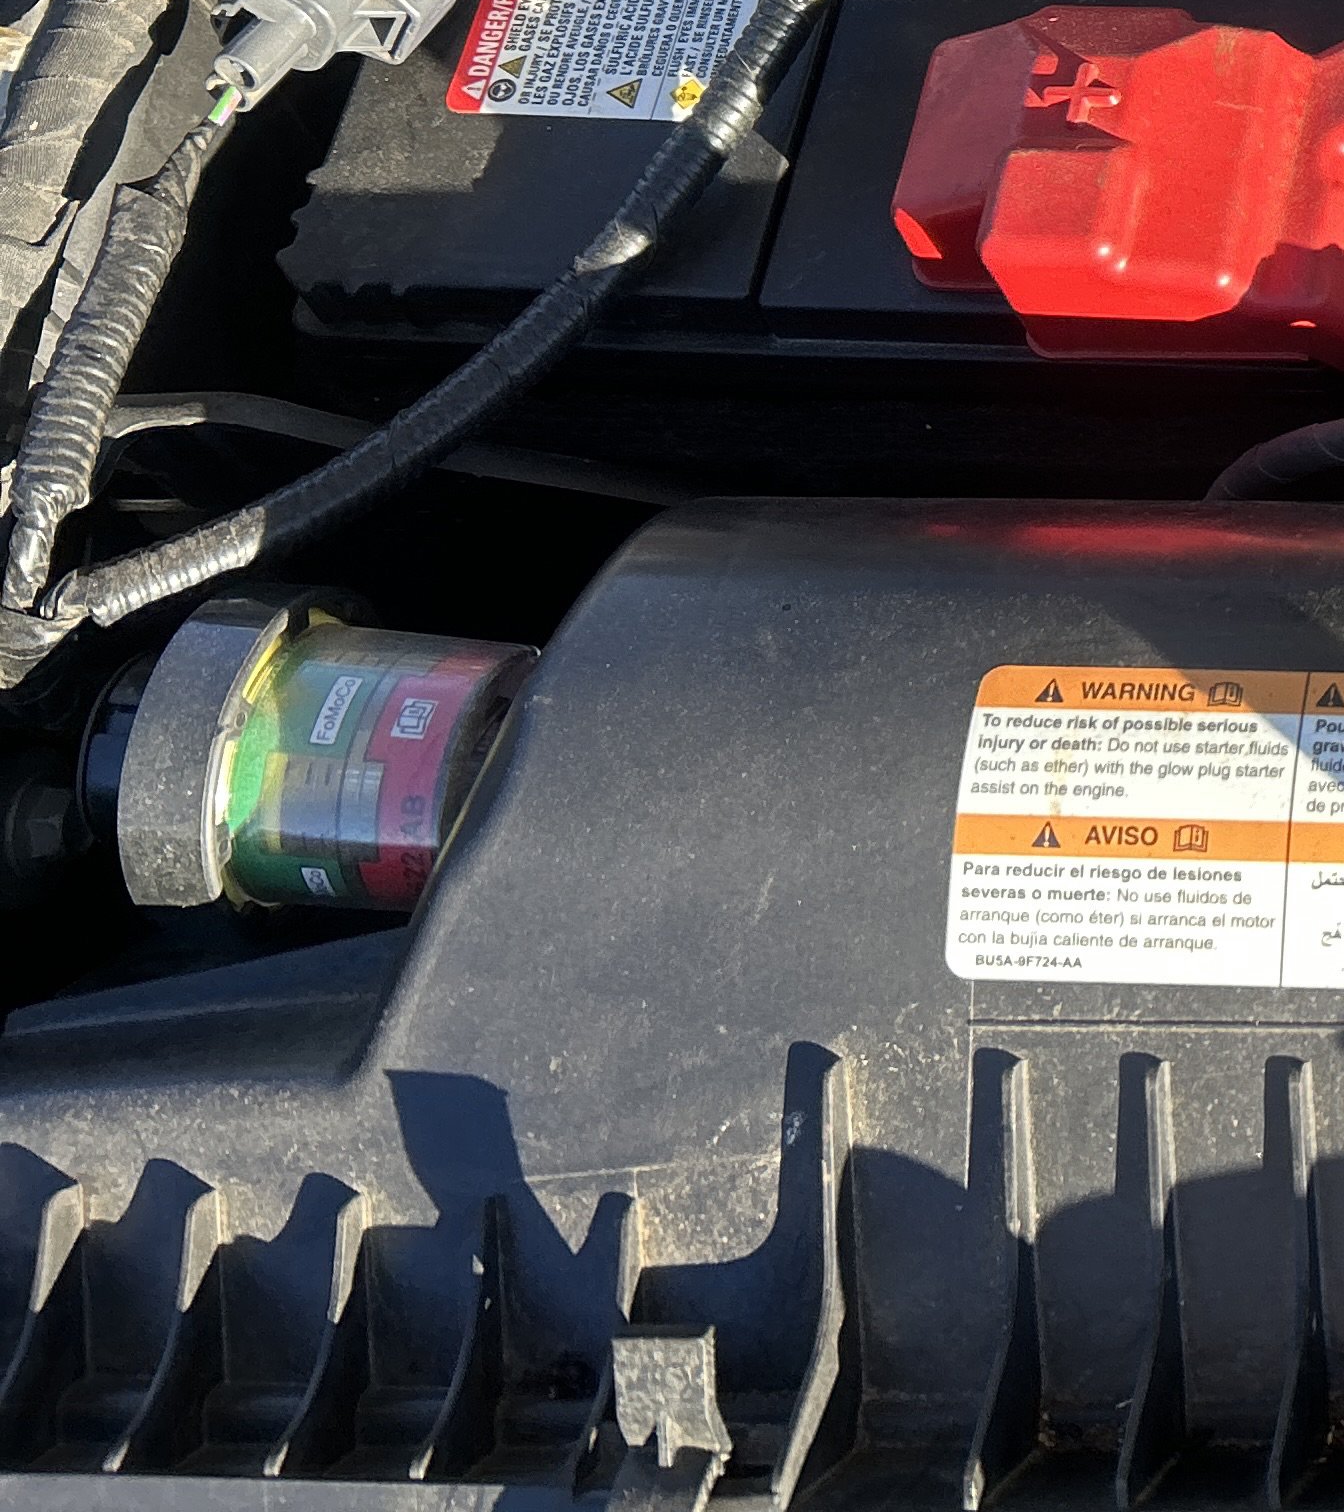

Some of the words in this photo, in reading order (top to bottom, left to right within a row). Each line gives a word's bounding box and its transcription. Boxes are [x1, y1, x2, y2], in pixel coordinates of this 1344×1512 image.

[504, 14, 526, 50] SHIELD
[519, 16, 539, 50] GASES
[581, 13, 601, 47] GASES
[574, 51, 589, 70] LOS
[604, 24, 631, 74] SULFURIC
[1079, 679, 1196, 702] WARNING
[314, 676, 356, 741] FoMoCo
[981, 711, 1002, 727] To
[1005, 713, 1063, 729] reduce
[1065, 714, 1097, 730] risk
[1101, 715, 1120, 730] of
[1122, 715, 1193, 736] possible
[1196, 717, 1258, 733] serious
[976, 734, 1025, 753] injury
[1028, 737, 1047, 750] or
[1050, 736, 1103, 752] death:
[1106, 737, 1130, 752] Do
[1133, 739, 1159, 753] not
[1162, 741, 1191, 754] use
[1194, 739, 1244, 755] starter
[1248, 740, 1290, 756] fluids
[973, 756, 1017, 773] (such
[1019, 760, 1039, 773] as
[1042, 757, 1089, 776] ether)
[1093, 759, 1125, 774] with
[1128, 760, 1153, 775] the
[1156, 761, 1193, 779] glow
[1196, 761, 1231, 781] plug
[1234, 761, 1285, 778] starter
[969, 779, 1016, 795] assist
[1018, 782, 1039, 795] on
[1043, 781, 1068, 796] the
[1071, 781, 1130, 800] engine.
[1307, 779, 1344, 793] avec
[1305, 798, 1326, 813] de
[1084, 824, 1160, 847] AVISO
[962, 861, 1001, 876] Para
[1004, 861, 1066, 879] reducir
[1069, 864, 1085, 878] el
[1088, 864, 1143, 883] riesgo
[1146, 866, 1167, 881] de
[1172, 866, 1243, 882] lesiones
[961, 884, 1027, 899] severas
[1030, 887, 1043, 900] o
[1046, 886, 1112, 902] muerte:
[1116, 888, 1139, 902] No
[1142, 890, 1172, 903] use
[1176, 889, 1229, 905] fluidos
[1231, 891, 1252, 905] de
[958, 907, 1031, 926] arranque
[1034, 909, 1084, 926] (como
[1087, 909, 1125, 927] éter)
[1129, 911, 1143, 925] si
[1147, 912, 1207, 927] arranca
[1210, 913, 1226, 927] el
[1229, 914, 1276, 929] motor
[957, 930, 987, 944] con
[991, 930, 1006, 945] la
[1052, 931, 1114, 947] caliente
[1117, 933, 1139, 948] de
[1142, 935, 1217, 953] arranque.
